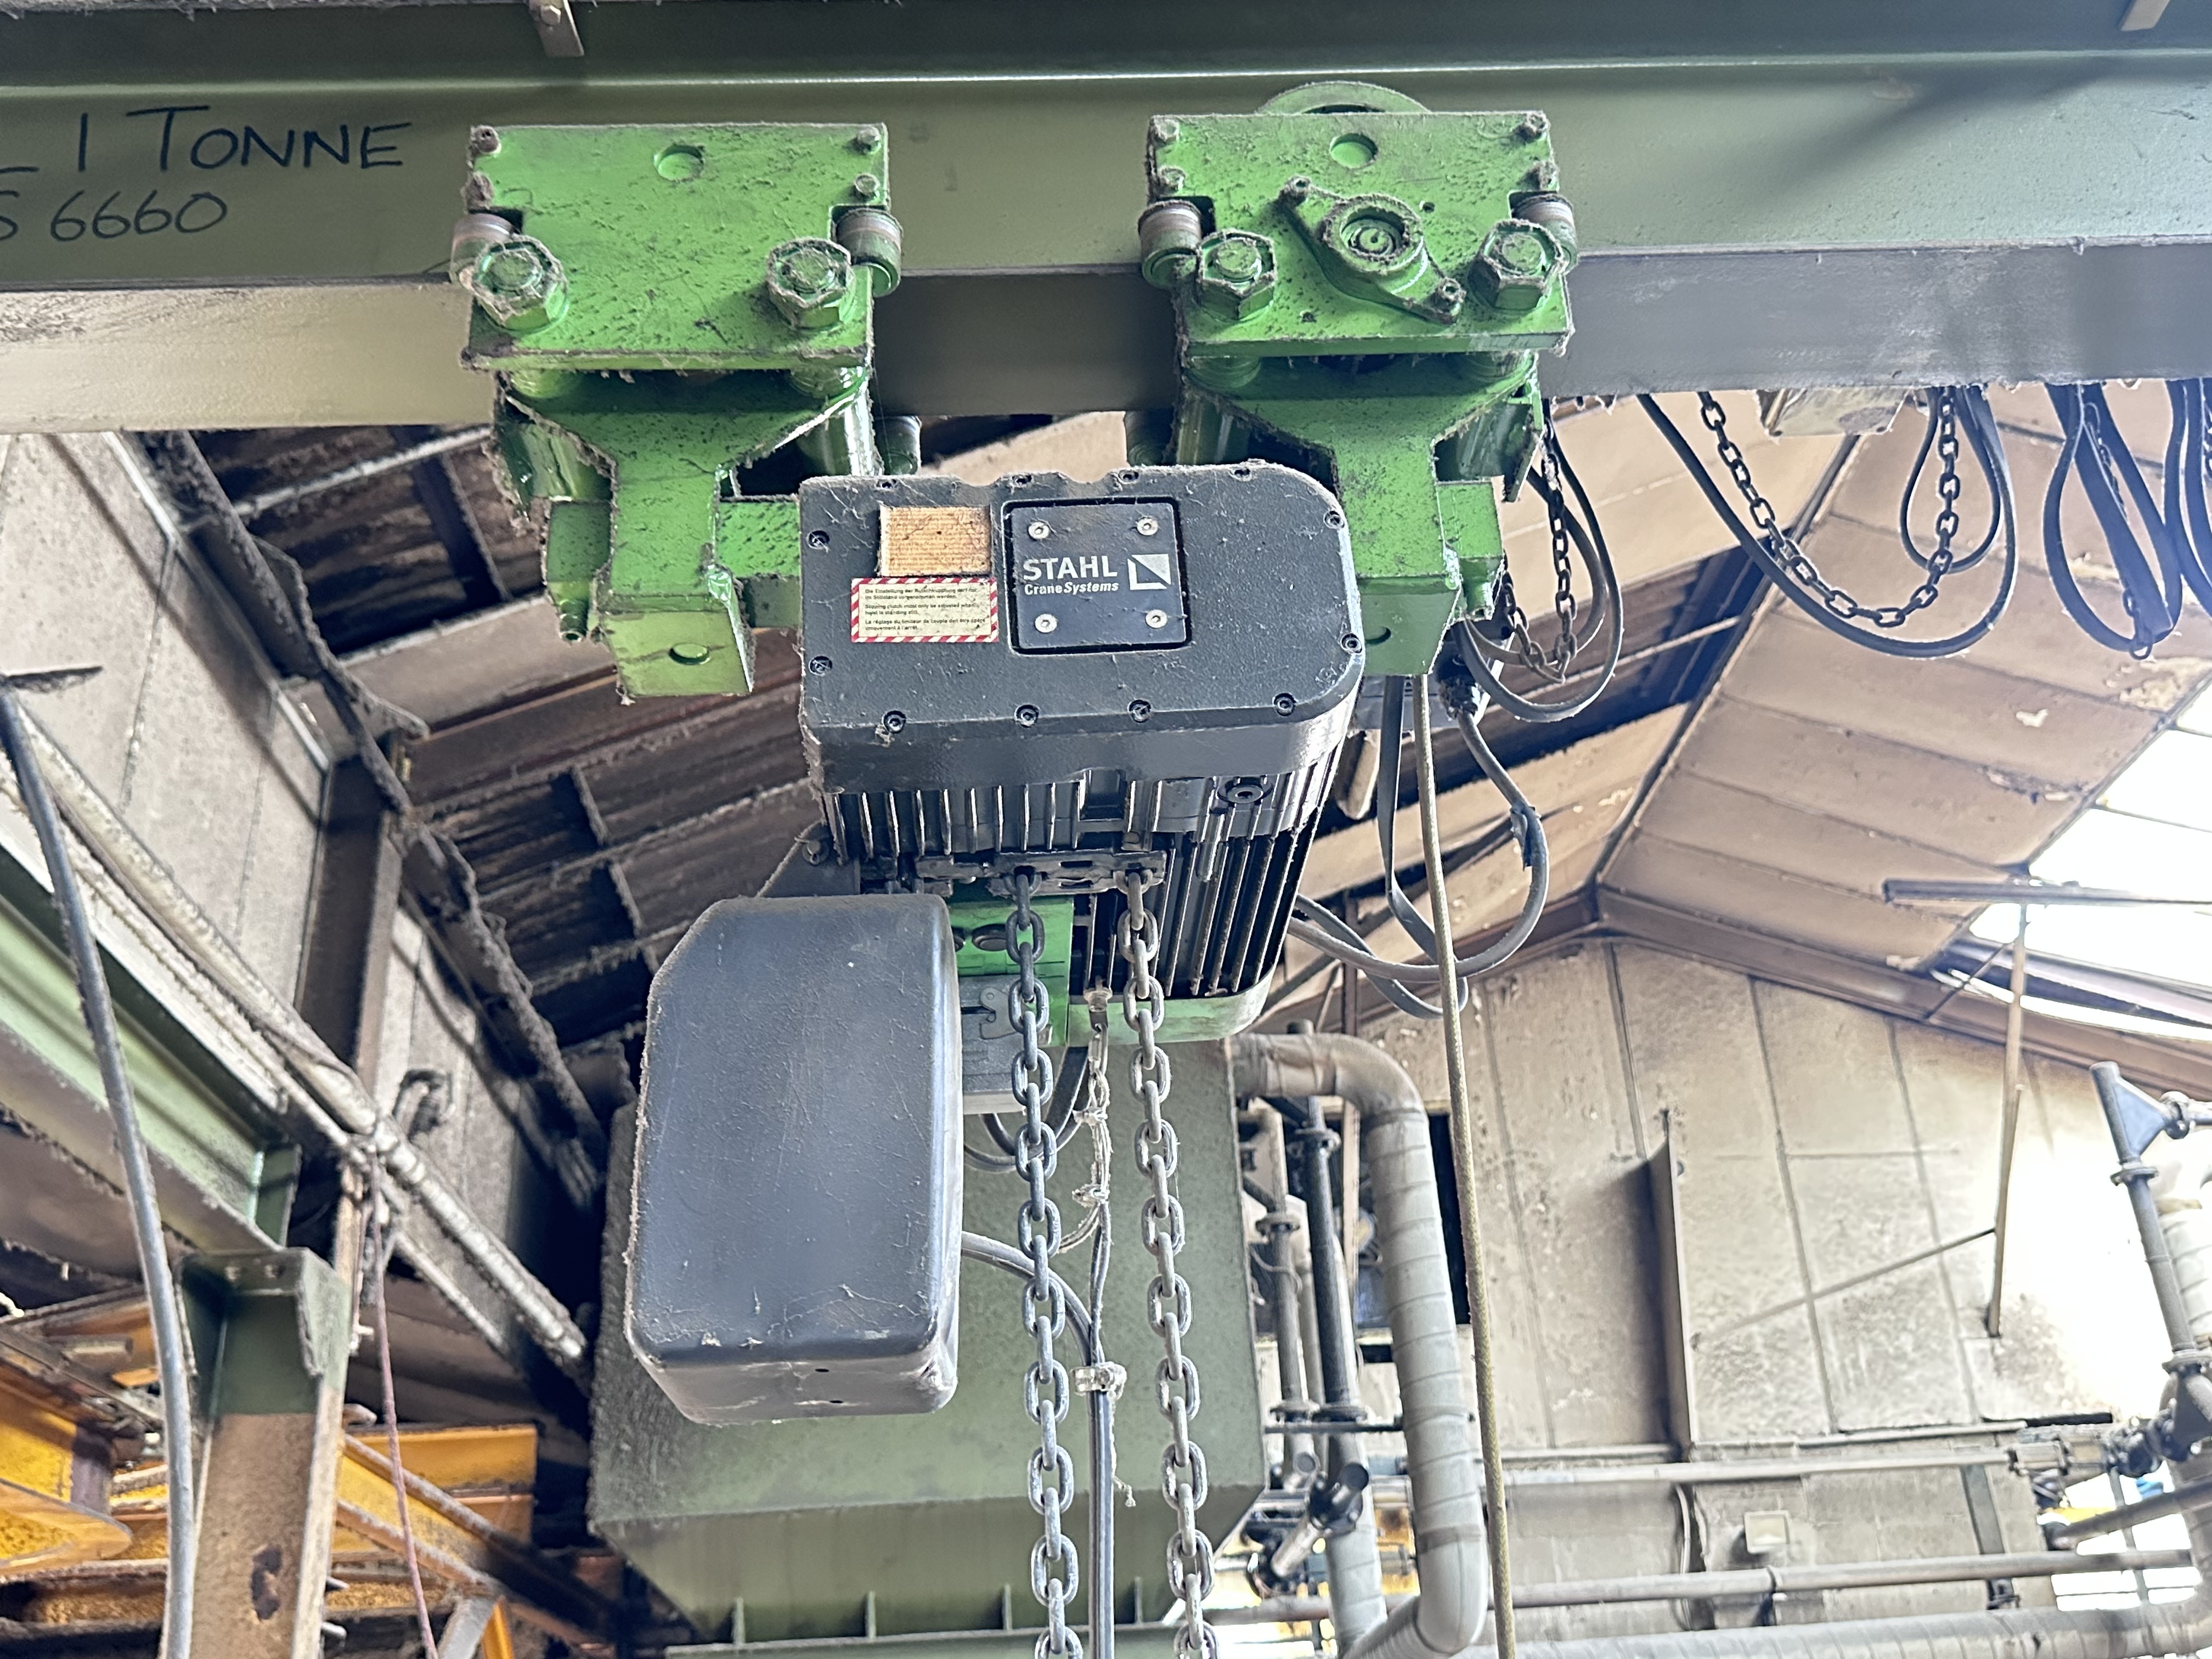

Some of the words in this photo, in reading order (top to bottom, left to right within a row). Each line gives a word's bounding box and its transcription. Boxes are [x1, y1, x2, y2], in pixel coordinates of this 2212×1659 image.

[125, 105, 412, 172] TONNE
[50, 189, 228, 242] 6660
[1023, 555, 1118, 581] STAHL
[1024, 581, 1119, 595] CraneSystems
